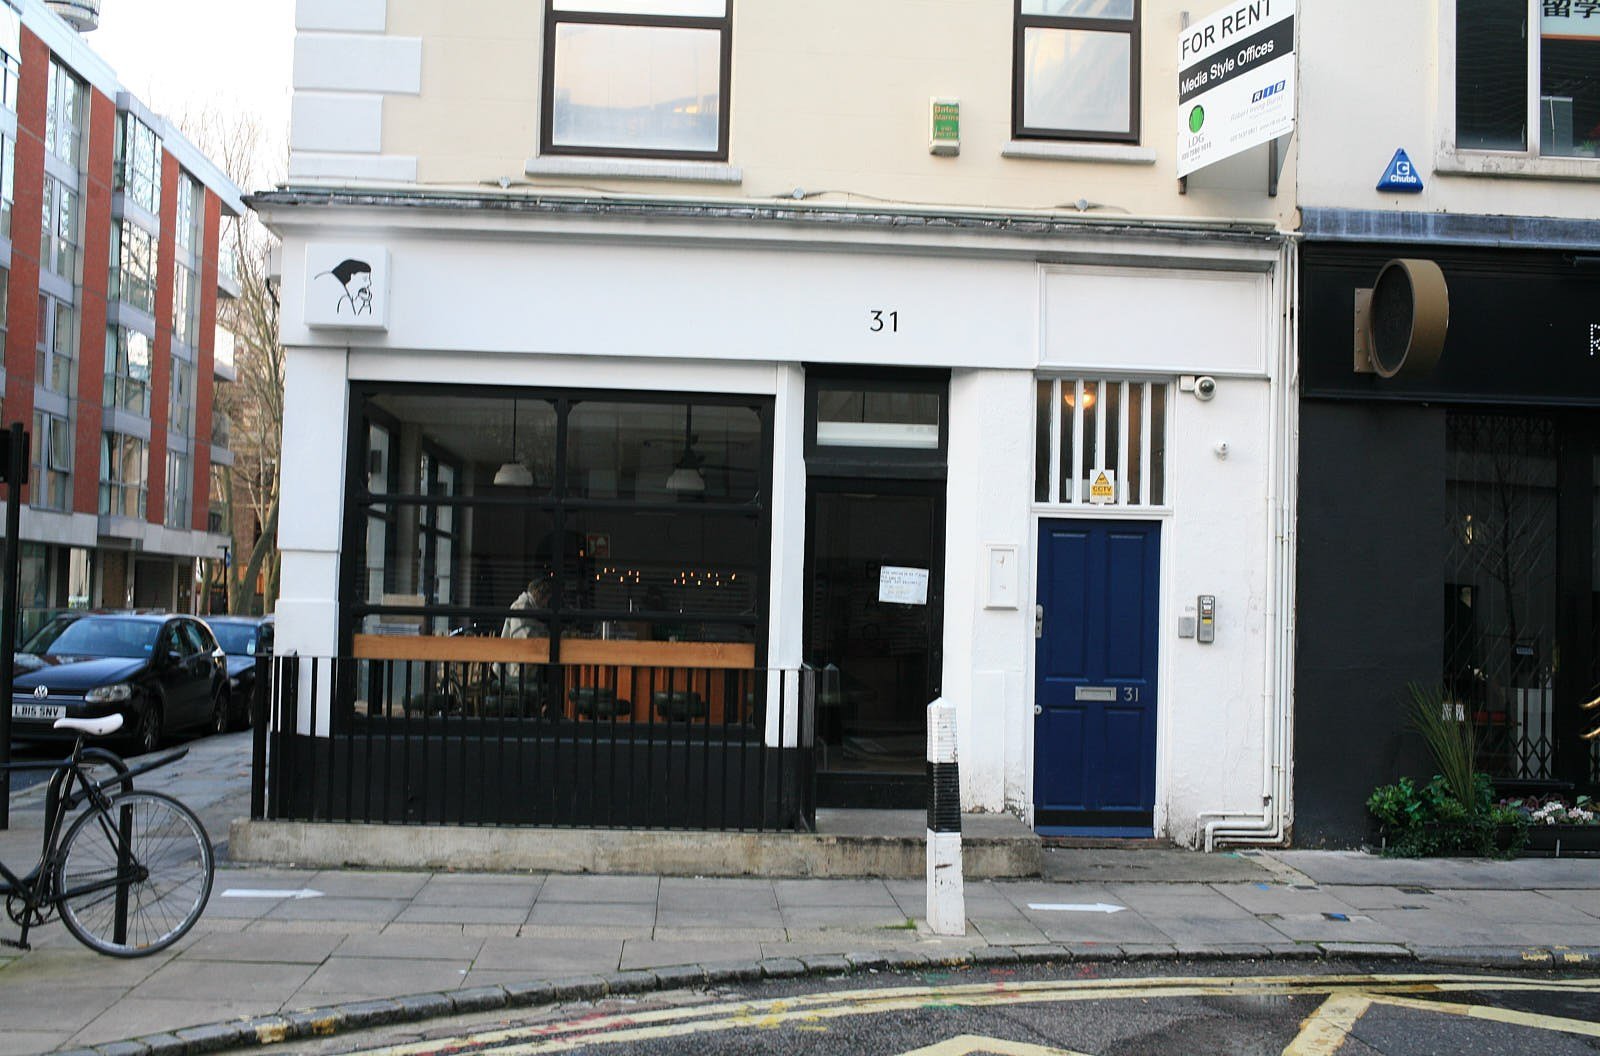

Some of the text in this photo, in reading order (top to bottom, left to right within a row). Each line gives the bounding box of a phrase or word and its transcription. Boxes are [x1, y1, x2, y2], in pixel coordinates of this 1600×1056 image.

[1182, 0, 1273, 60] FOR RENT
[1181, 39, 1274, 96] Media Style Offices
[1390, 175, 1417, 183] Chubb
[870, 310, 898, 332] 31
[1123, 687, 1139, 703] 31
